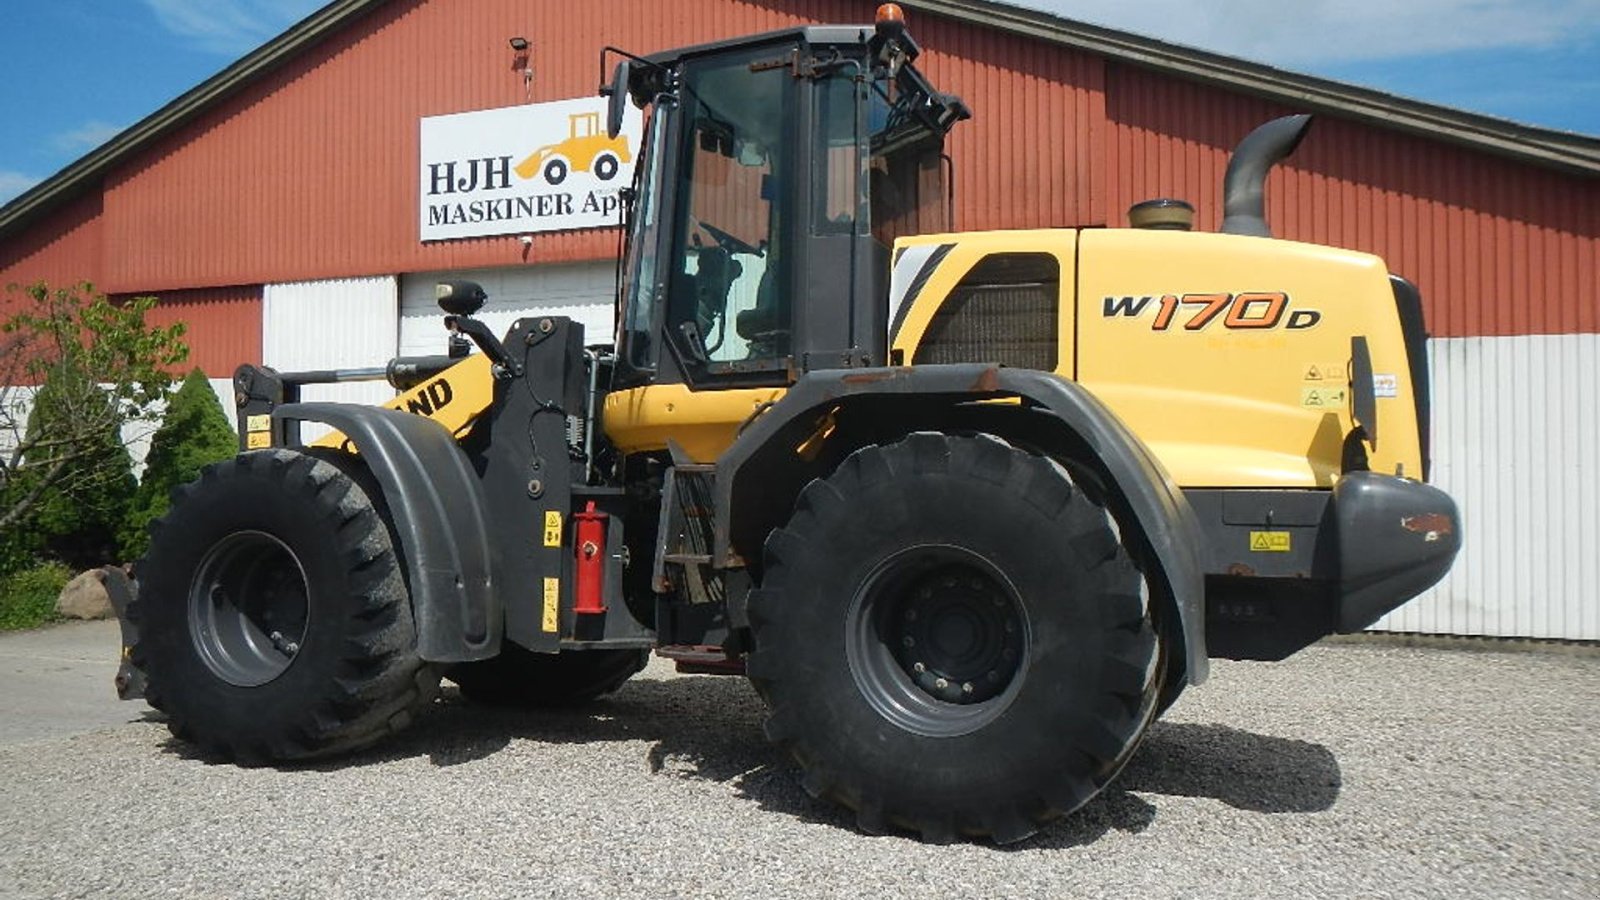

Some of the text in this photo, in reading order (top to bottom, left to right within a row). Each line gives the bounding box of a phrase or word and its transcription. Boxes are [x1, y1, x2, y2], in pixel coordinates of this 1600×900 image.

[427, 155, 513, 196] HJH
[428, 192, 574, 226] MASKINER
[395, 378, 453, 416] ND
